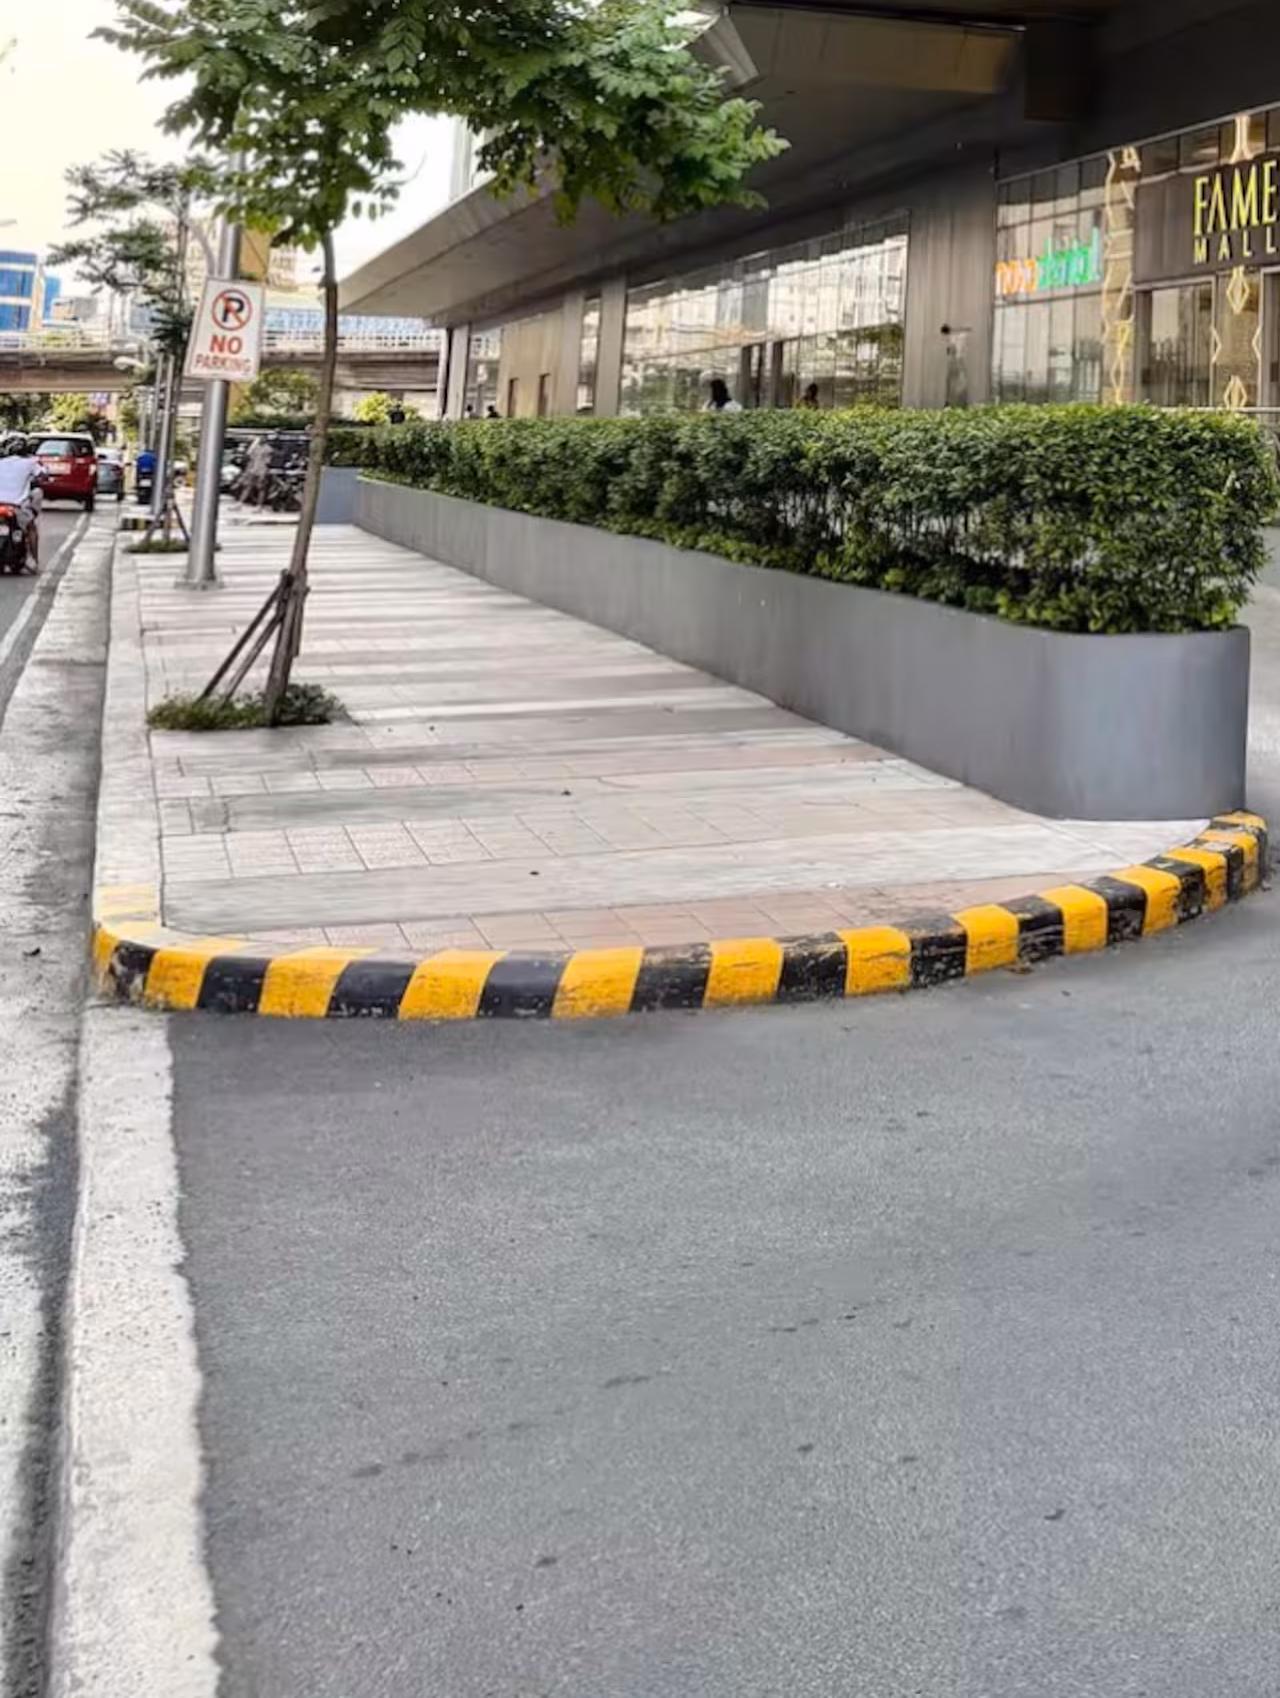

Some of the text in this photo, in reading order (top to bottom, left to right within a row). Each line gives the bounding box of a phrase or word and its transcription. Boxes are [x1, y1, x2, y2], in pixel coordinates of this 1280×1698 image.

[1194, 160, 1278, 235] FAME
[1193, 230, 1278, 264] MALL
[210, 334, 242, 354] NO
[195, 353, 252, 374] PARKING
